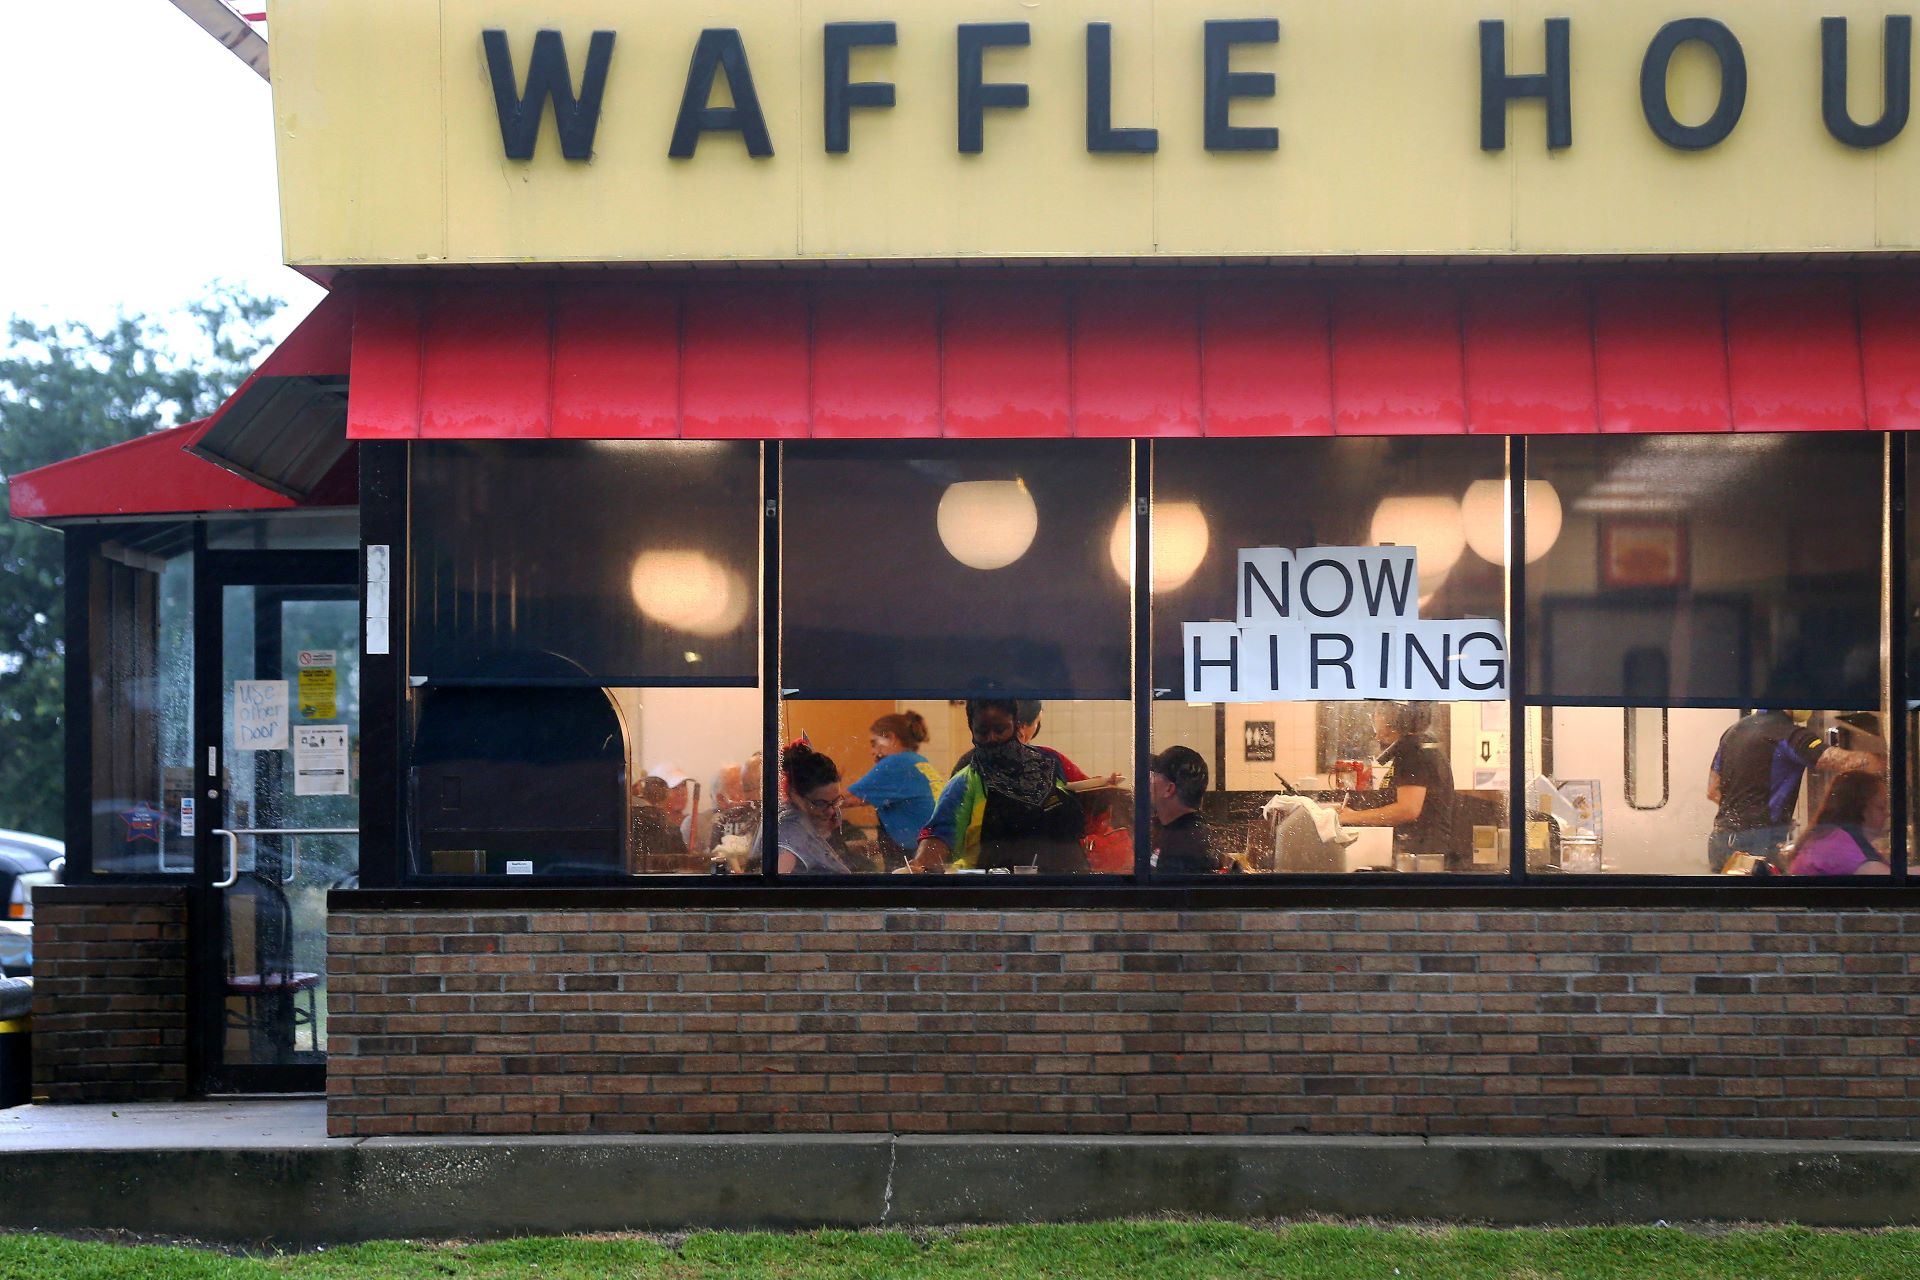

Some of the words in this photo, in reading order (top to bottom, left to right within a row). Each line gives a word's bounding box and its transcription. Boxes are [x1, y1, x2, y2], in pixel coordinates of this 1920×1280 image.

[483, 21, 1279, 161] WAFFLE
[1479, 14, 1913, 152] HOU
[1243, 557, 1415, 619] NOW
[1192, 631, 1506, 692] HIRING
